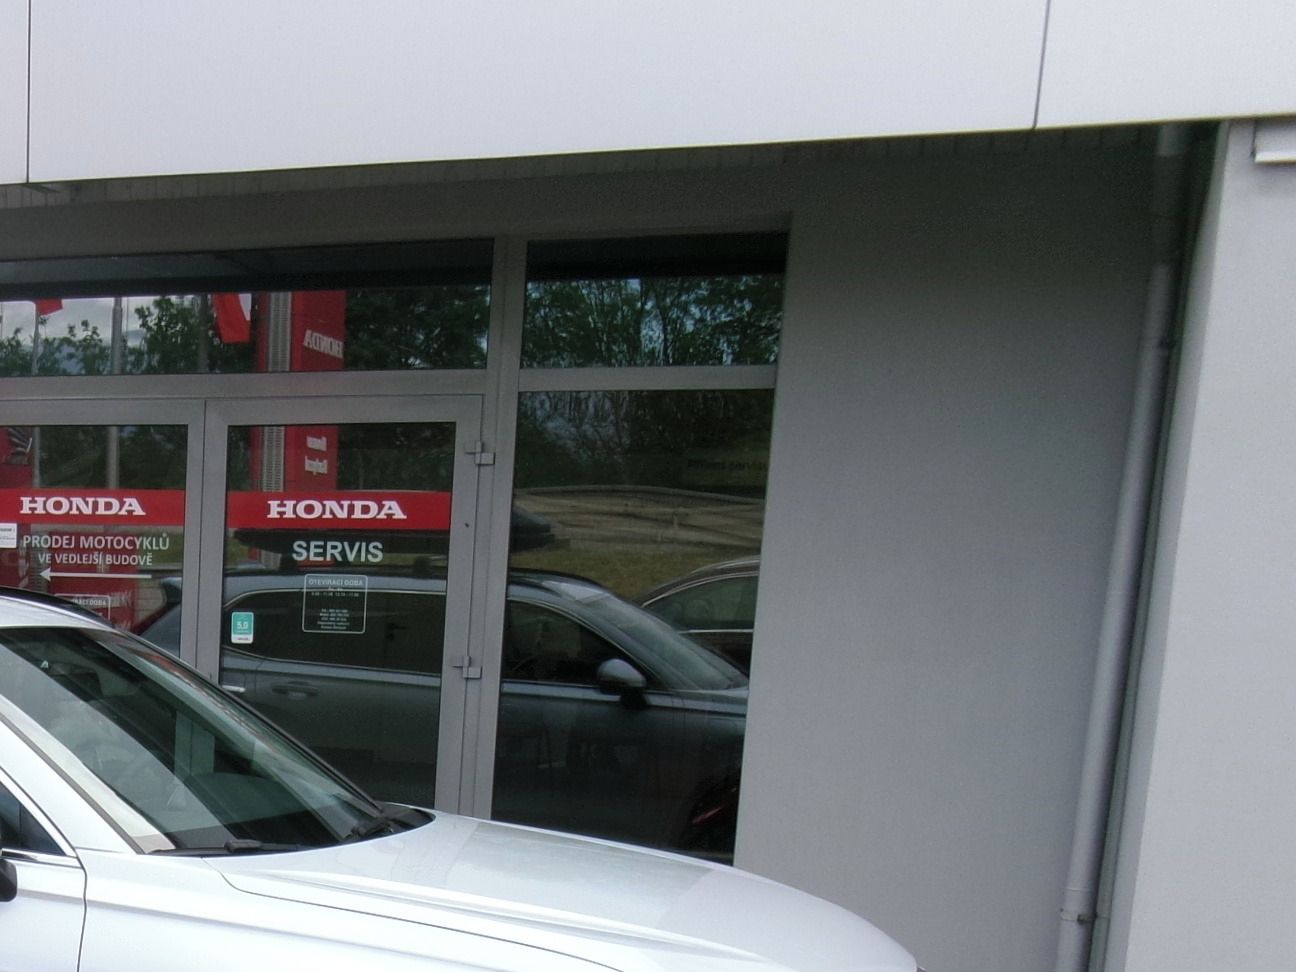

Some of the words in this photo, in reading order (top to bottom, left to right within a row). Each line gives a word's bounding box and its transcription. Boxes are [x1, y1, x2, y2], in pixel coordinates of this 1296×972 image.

[19, 496, 146, 516] HONDA
[266, 499, 407, 519] HONDA
[23, 534, 75, 549] PRODEJ
[79, 532, 170, 551] MOTOCYKLŮ
[292, 540, 383, 563] SERVIS
[38, 553, 51, 564] VE
[55, 551, 104, 565] VEDLEJŠÍ
[105, 552, 153, 566] BUDOVĚ
